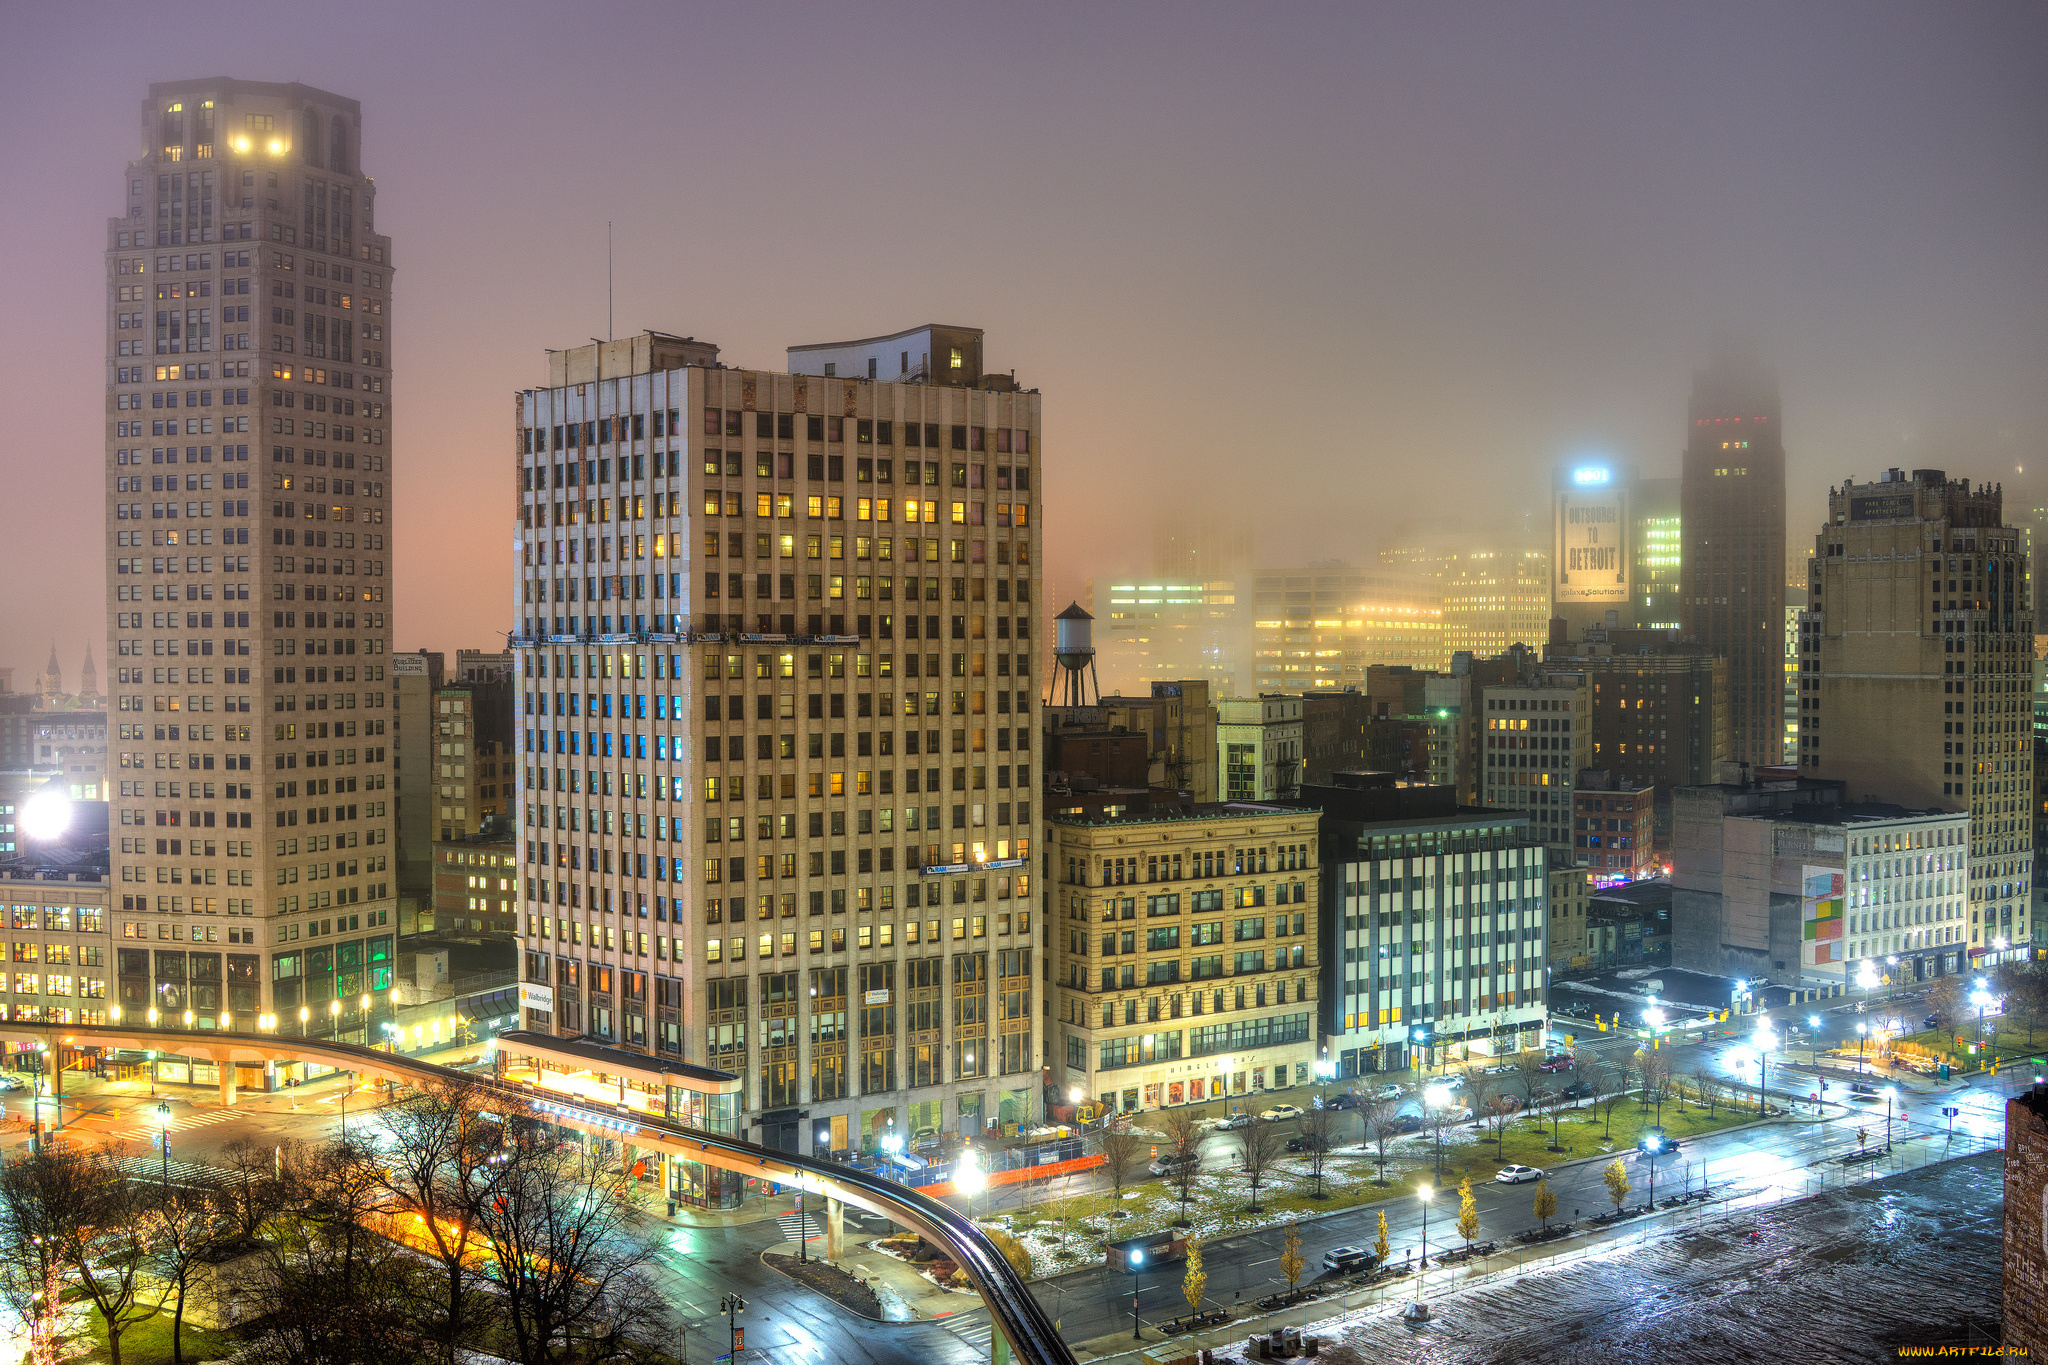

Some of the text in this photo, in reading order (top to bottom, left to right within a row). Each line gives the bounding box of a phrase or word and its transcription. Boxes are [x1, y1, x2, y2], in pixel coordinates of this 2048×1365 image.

[1575, 470, 1608, 482] 1001
[1569, 506, 1616, 524] OUTSOURCE
[1587, 527, 1598, 544] TO
[1569, 546, 1616, 571] DETROIT
[394, 664, 422, 672] BUILDING
[528, 992, 552, 1005] Walbridge
